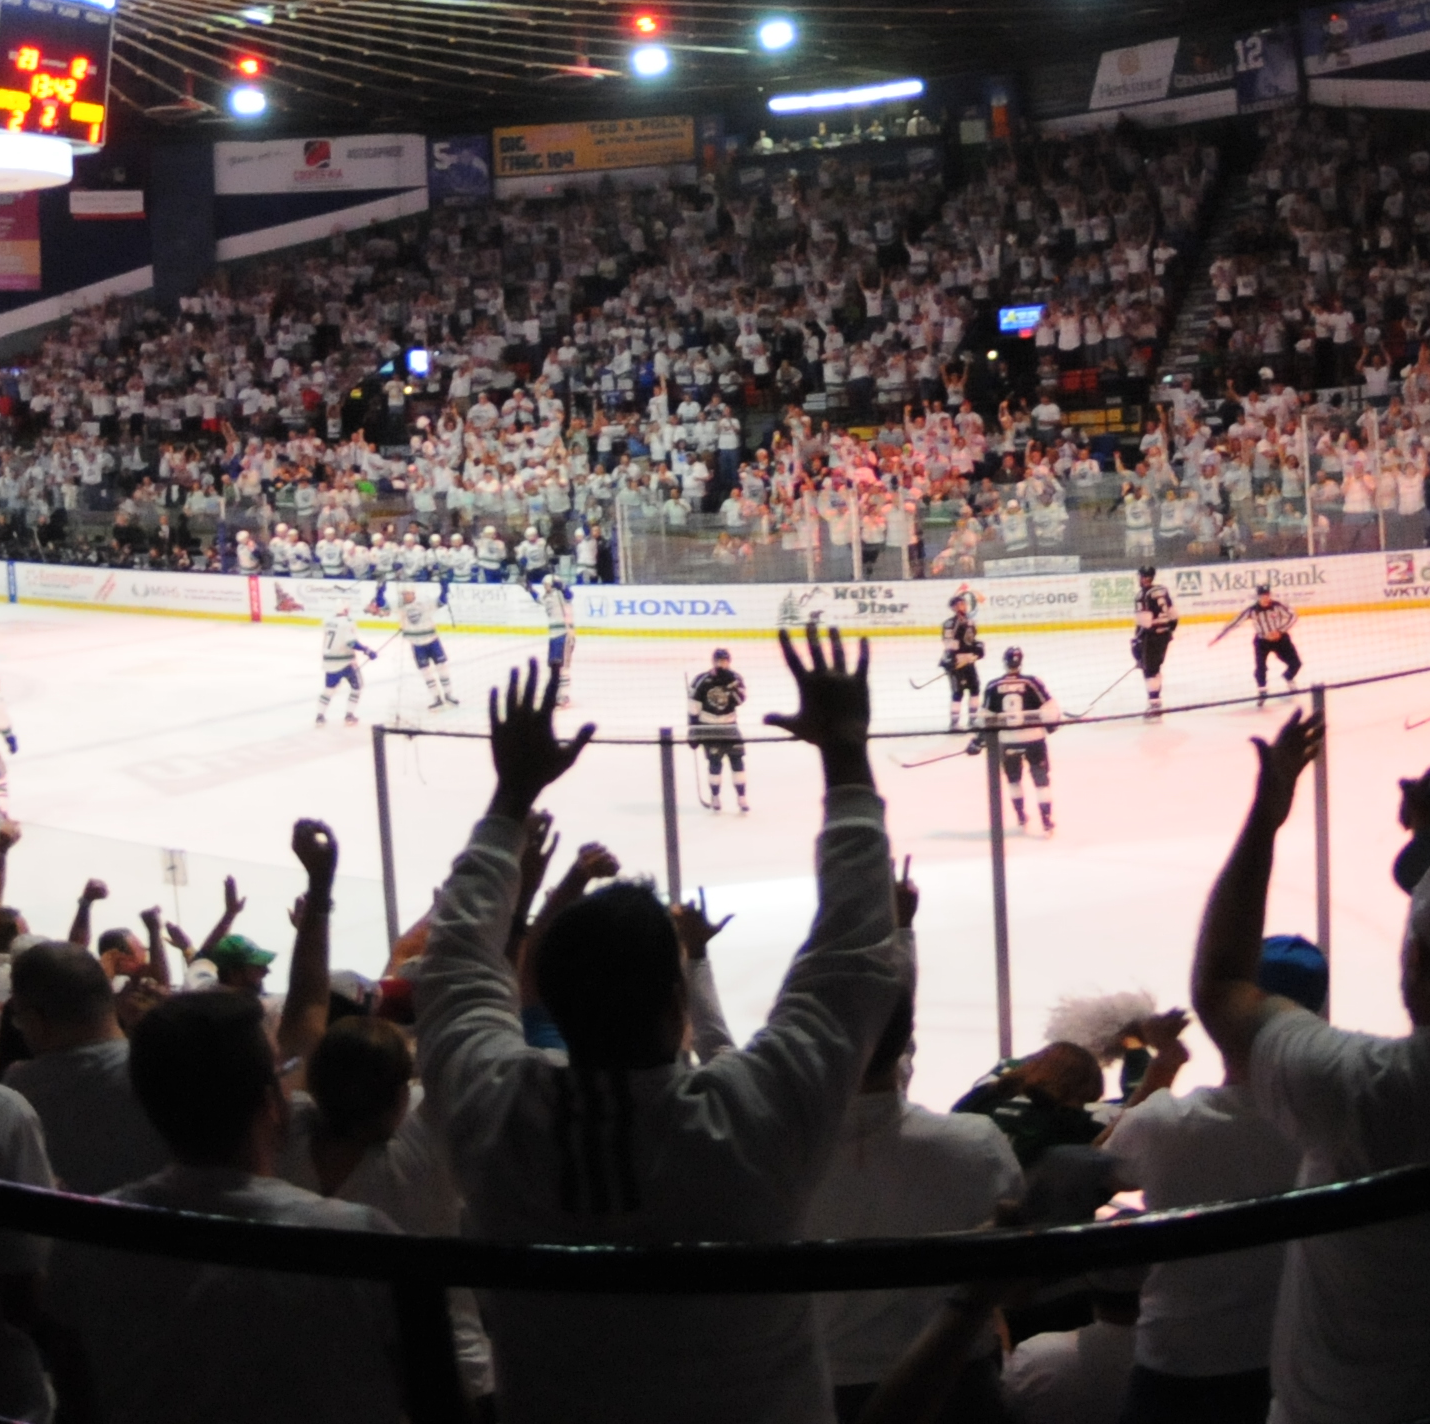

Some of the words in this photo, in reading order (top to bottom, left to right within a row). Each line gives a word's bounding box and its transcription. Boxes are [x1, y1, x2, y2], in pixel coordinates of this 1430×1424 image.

[1233, 35, 1265, 73] 12
[31, 73, 78, 104] 13:42
[8, 109, 26, 134] 2
[40, 105, 56, 128] 2
[89, 122, 101, 144] 1
[433, 142, 452, 171] 5
[1209, 571, 1263, 593] M&T
[1268, 564, 1326, 589] Bank
[833, 586, 895, 601] Walt's
[988, 590, 1079, 610] recycleone
[614, 599, 737, 616] HONDA
[856, 601, 909, 615] Diner
